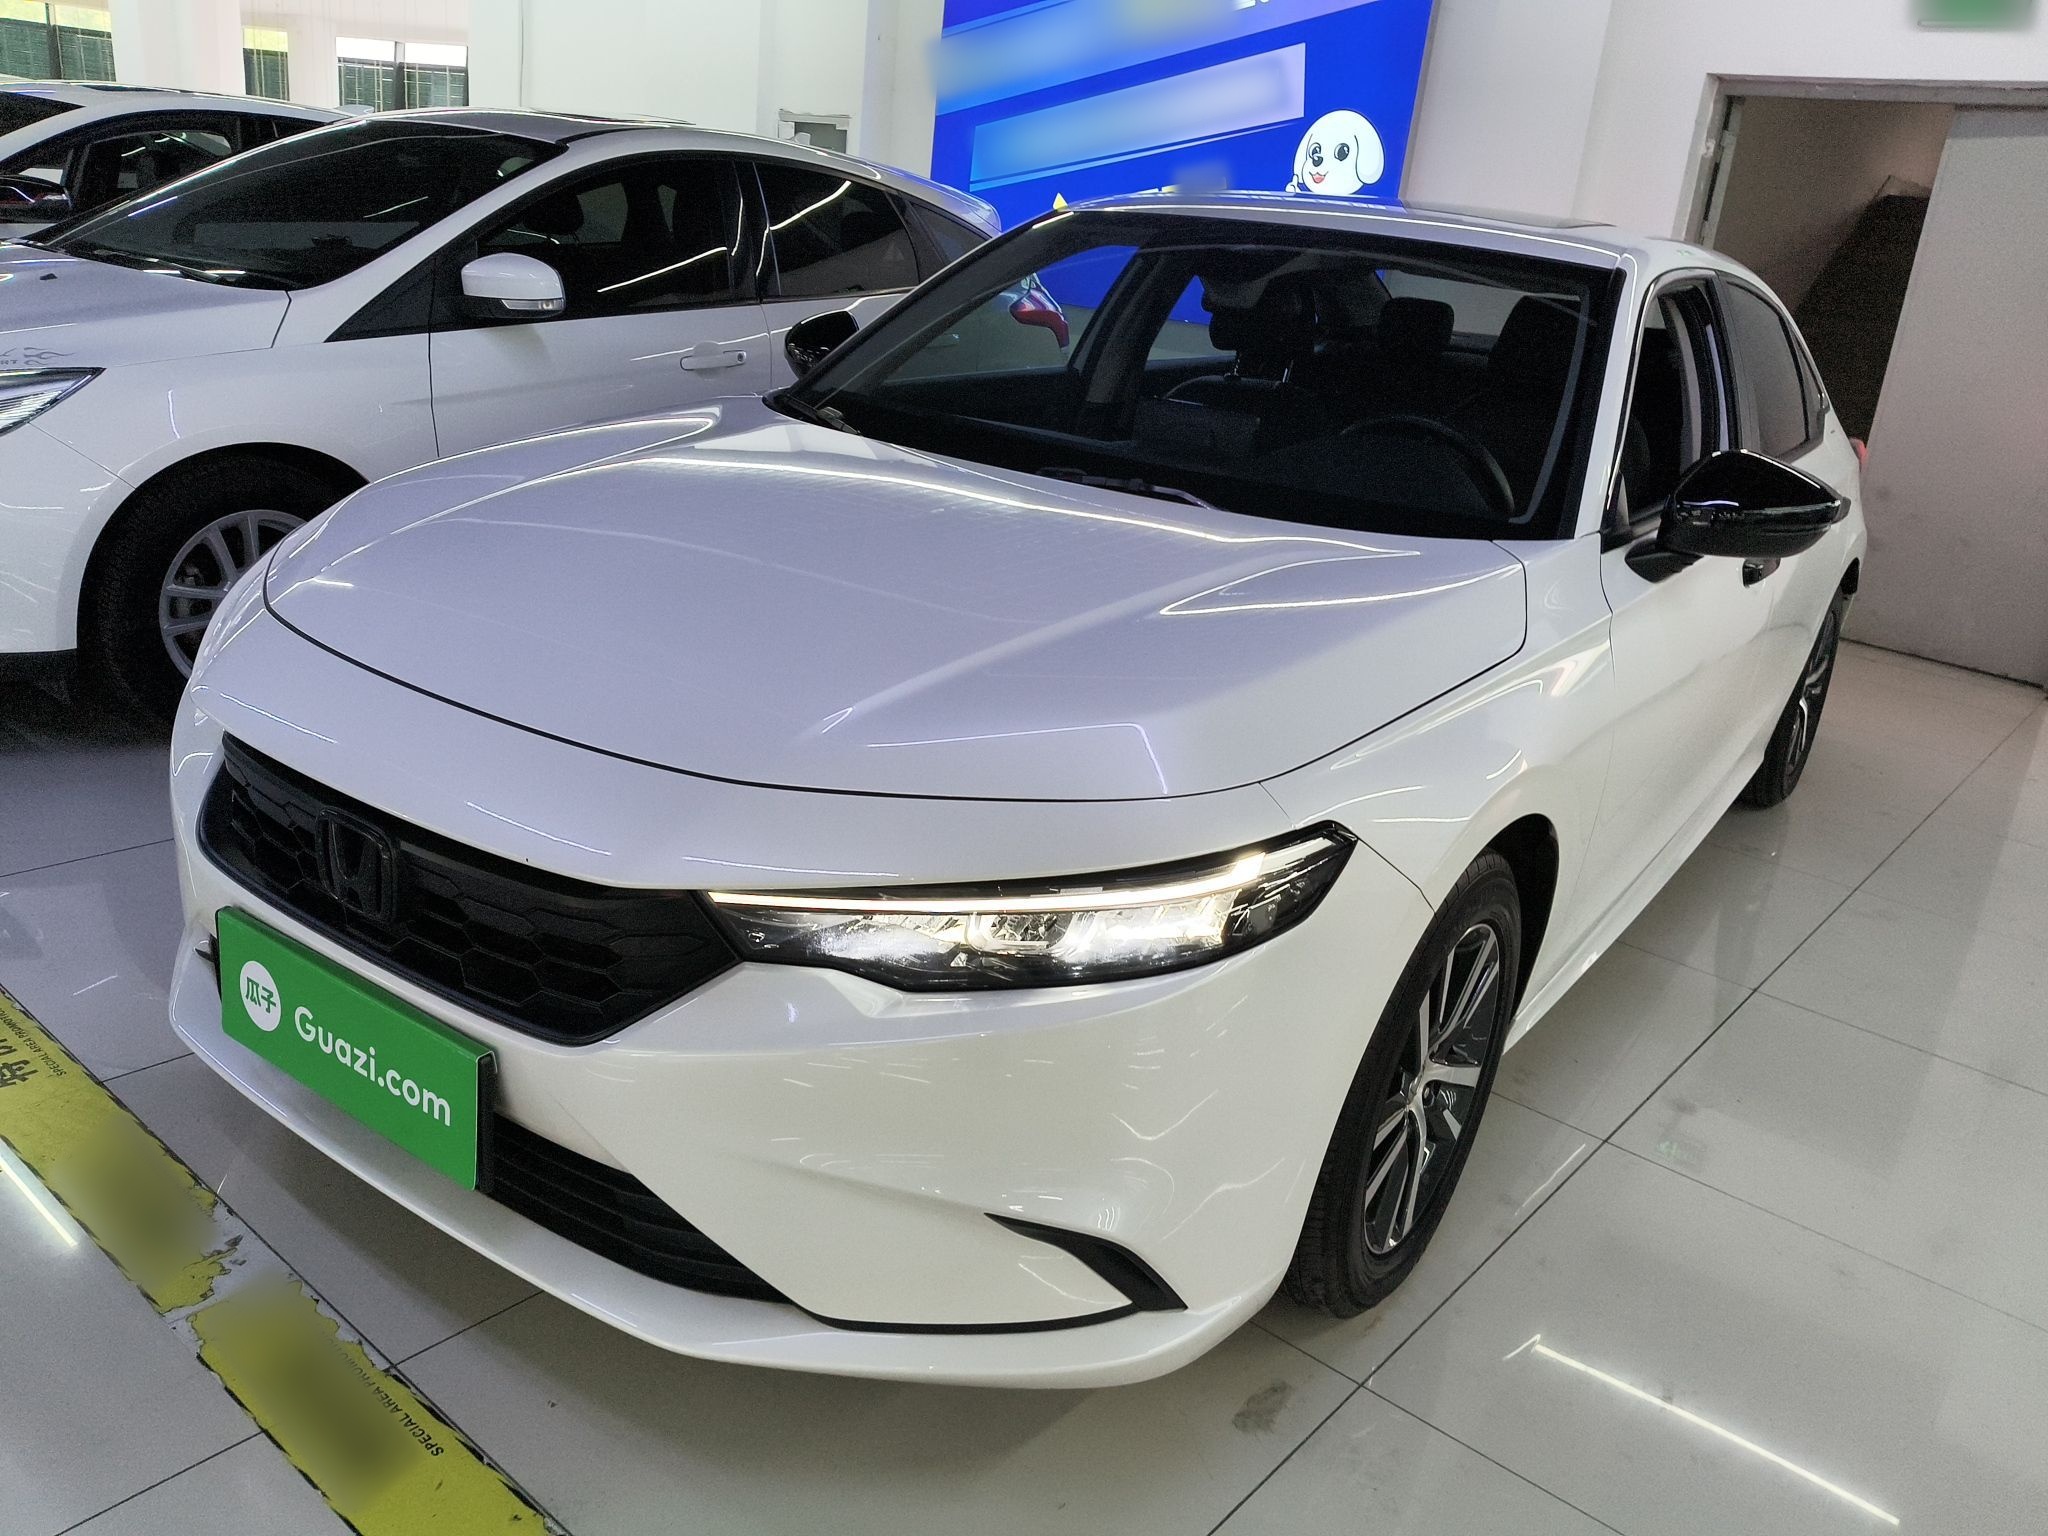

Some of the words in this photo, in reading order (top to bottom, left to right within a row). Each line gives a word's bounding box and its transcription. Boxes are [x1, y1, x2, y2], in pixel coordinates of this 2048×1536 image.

[245, 977, 276, 1014] 瓜子
[24, 1037, 42, 1053] AREA
[39, 1052, 67, 1076] SPECIAL
[294, 1006, 450, 1127] Guazi.com
[372, 1385, 403, 1414] AREA
[399, 1412, 444, 1457] SPECIAL
